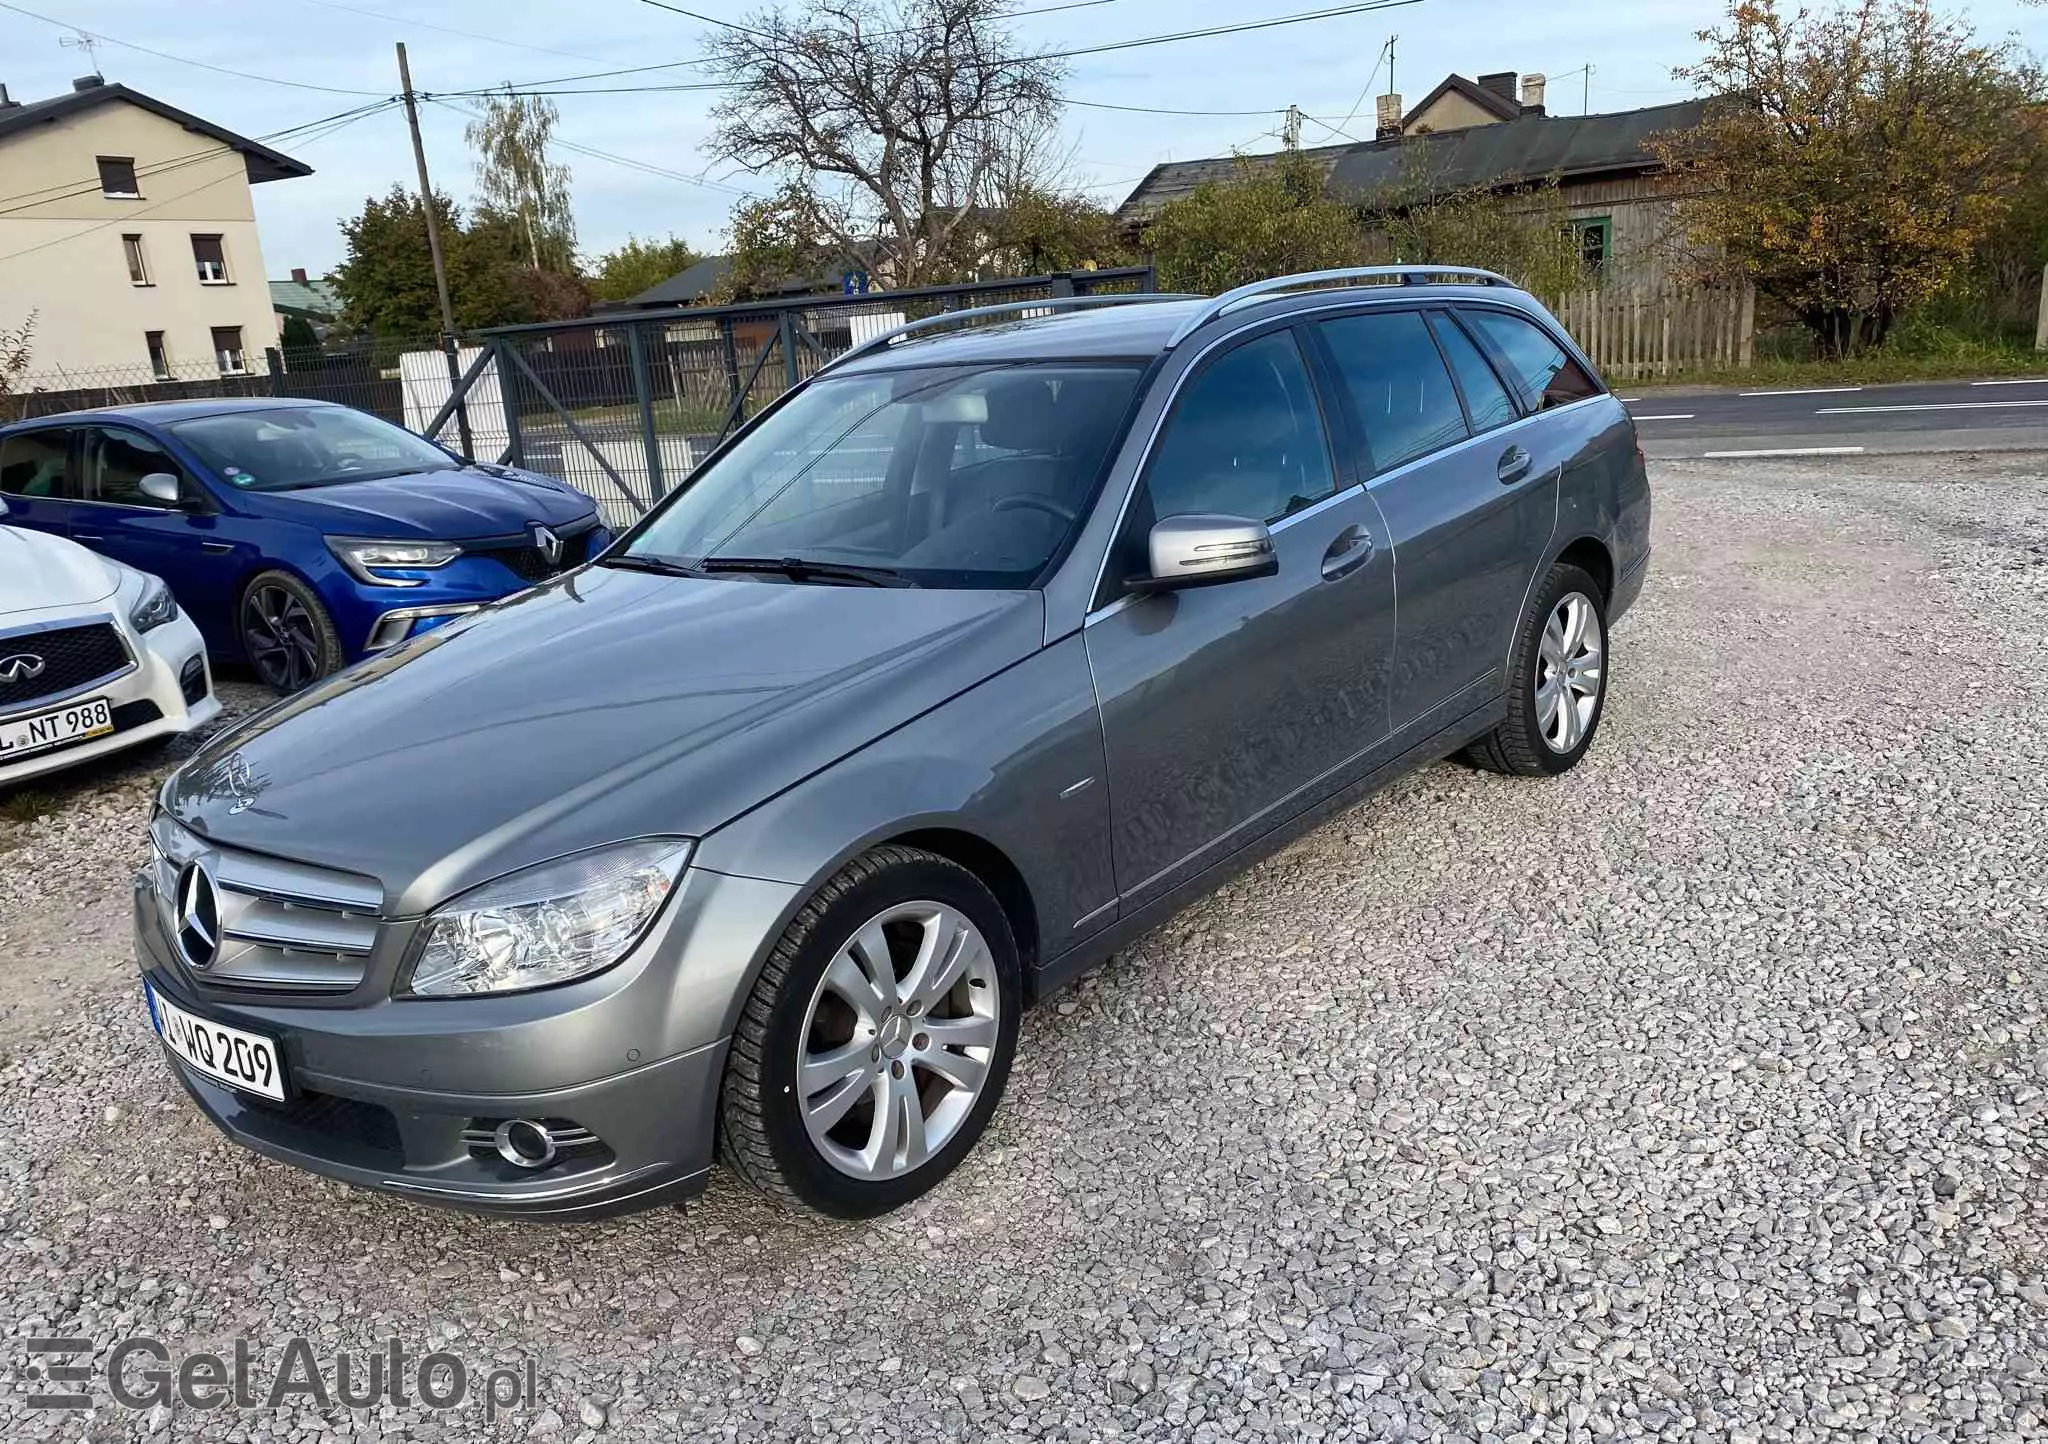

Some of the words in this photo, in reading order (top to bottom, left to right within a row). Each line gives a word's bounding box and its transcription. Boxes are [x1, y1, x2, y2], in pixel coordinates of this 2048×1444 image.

[29, 715, 60, 744] NT
[66, 703, 108, 733] 988
[179, 1015, 217, 1070] WQ
[216, 1031, 272, 1088] 209
